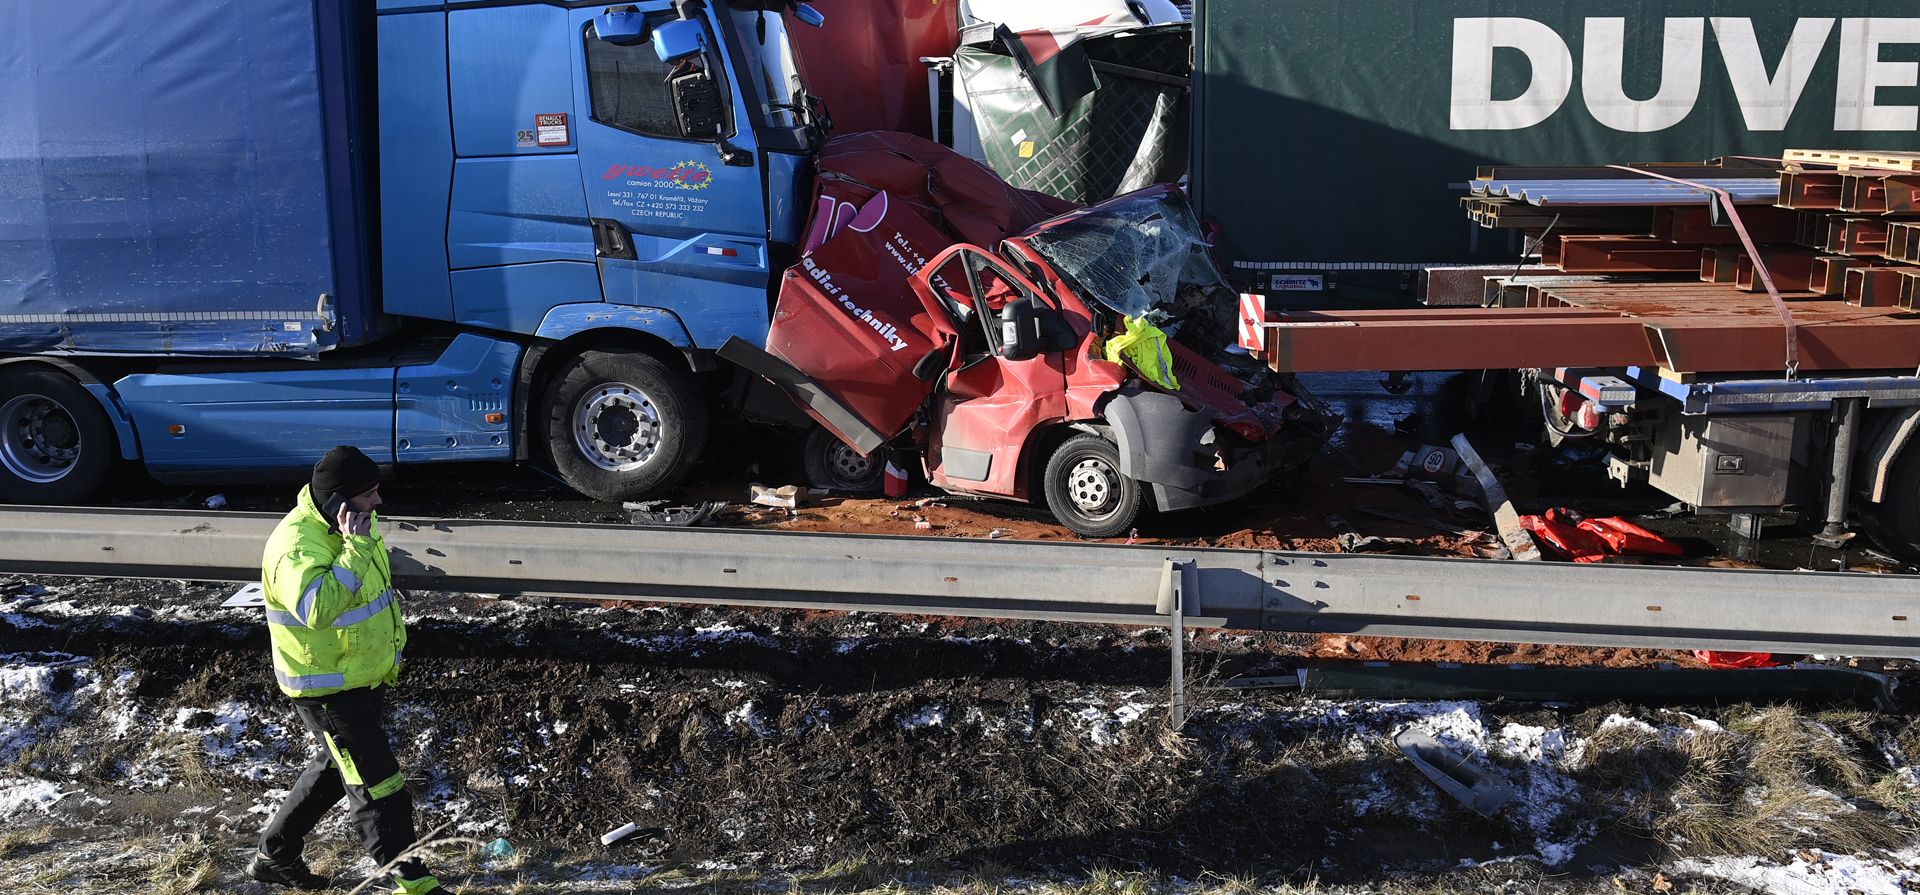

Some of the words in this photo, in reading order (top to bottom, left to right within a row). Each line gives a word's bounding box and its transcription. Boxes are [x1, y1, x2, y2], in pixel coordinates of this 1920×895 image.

[1450, 17, 1920, 132] DUVE
[517, 130, 534, 142] 25
[654, 180, 674, 189] 2000
[607, 190, 621, 198] Lesní
[622, 191, 636, 199] 331,
[631, 209, 653, 217] CZECH
[655, 210, 684, 219] REPUBLIC
[894, 231, 912, 253] Tel.:
[802, 257, 842, 295] adicí
[838, 294, 909, 352] techniky
[1427, 453, 1443, 466] 90
